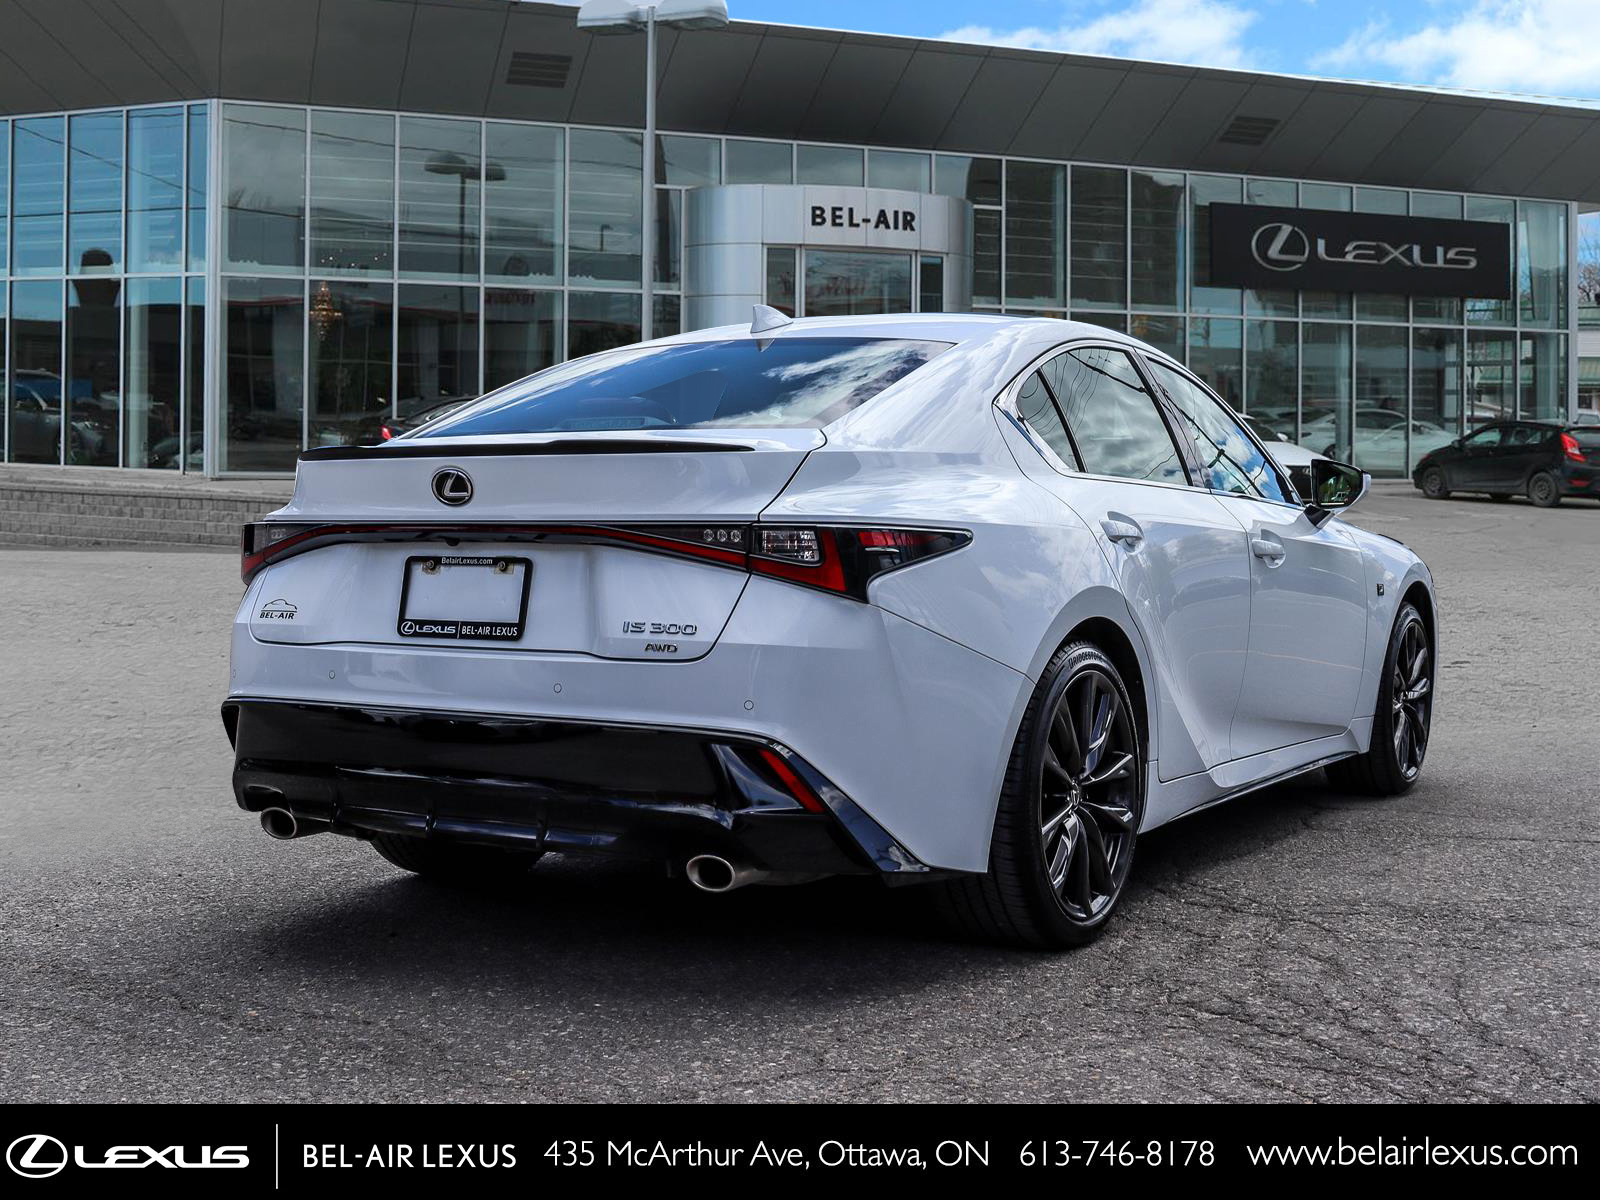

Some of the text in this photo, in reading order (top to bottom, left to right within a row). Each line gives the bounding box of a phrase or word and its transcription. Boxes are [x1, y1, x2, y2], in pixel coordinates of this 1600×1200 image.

[811, 206, 916, 231] BEL-AIR
[1317, 238, 1477, 269] LEXUS
[441, 557, 493, 565] BelairLexus.com
[416, 625, 456, 634] LEXUS
[461, 626, 518, 636] BEL-AIR LEXUS
[622, 621, 698, 635] IS 300
[644, 643, 678, 653] AWD
